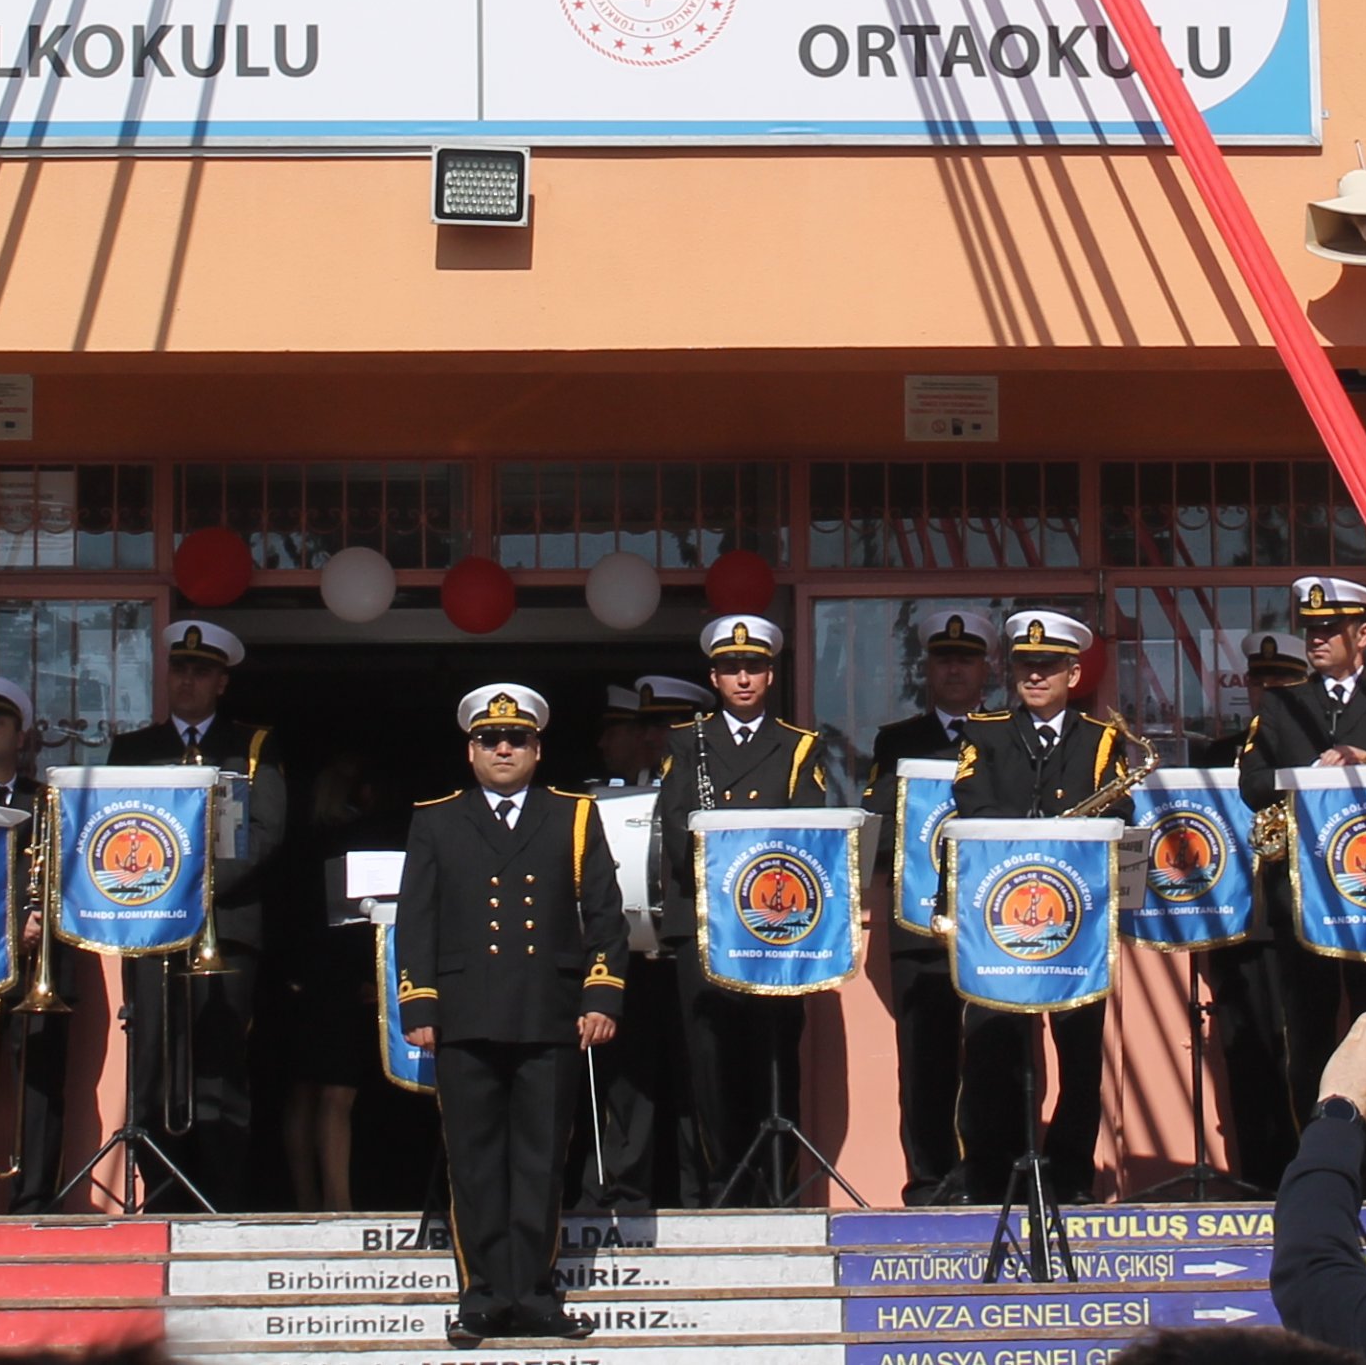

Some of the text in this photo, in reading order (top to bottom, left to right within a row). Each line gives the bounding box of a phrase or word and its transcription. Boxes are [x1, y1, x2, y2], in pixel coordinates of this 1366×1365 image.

[798, 24, 1231, 80] ORTAOKUU
[76, 810, 104, 855] AKDENİZ
[103, 800, 142, 814] BÖLGE
[156, 807, 192, 856] GARNİZON
[721, 851, 750, 895] AKDENİZ
[748, 840, 784, 856] BÖLGE
[798, 848, 834, 899] GARNİZON
[972, 864, 1004, 909] AKDENİZ
[1002, 852, 1042, 869] BÖLGE
[1057, 859, 1094, 911] GARNİZON
[79, 908, 188, 920] BANDO KOMUTANLIĞI
[728, 948, 833, 960] BANDO KOMUTANLIĞI
[976, 965, 1089, 976] BANDO KOMUTANLIĞI
[408, 1049, 435, 1060] BAN
[362, 1223, 417, 1251] BİZ
[1198, 1213, 1275, 1238] SAVA
[267, 1270, 451, 1291] Birbirimizden
[1115, 1254, 1174, 1282] ÇIKIŞI
[266, 1314, 425, 1335] Birbirimizle
[877, 1297, 1150, 1330] HAVZA GENELGESİ
